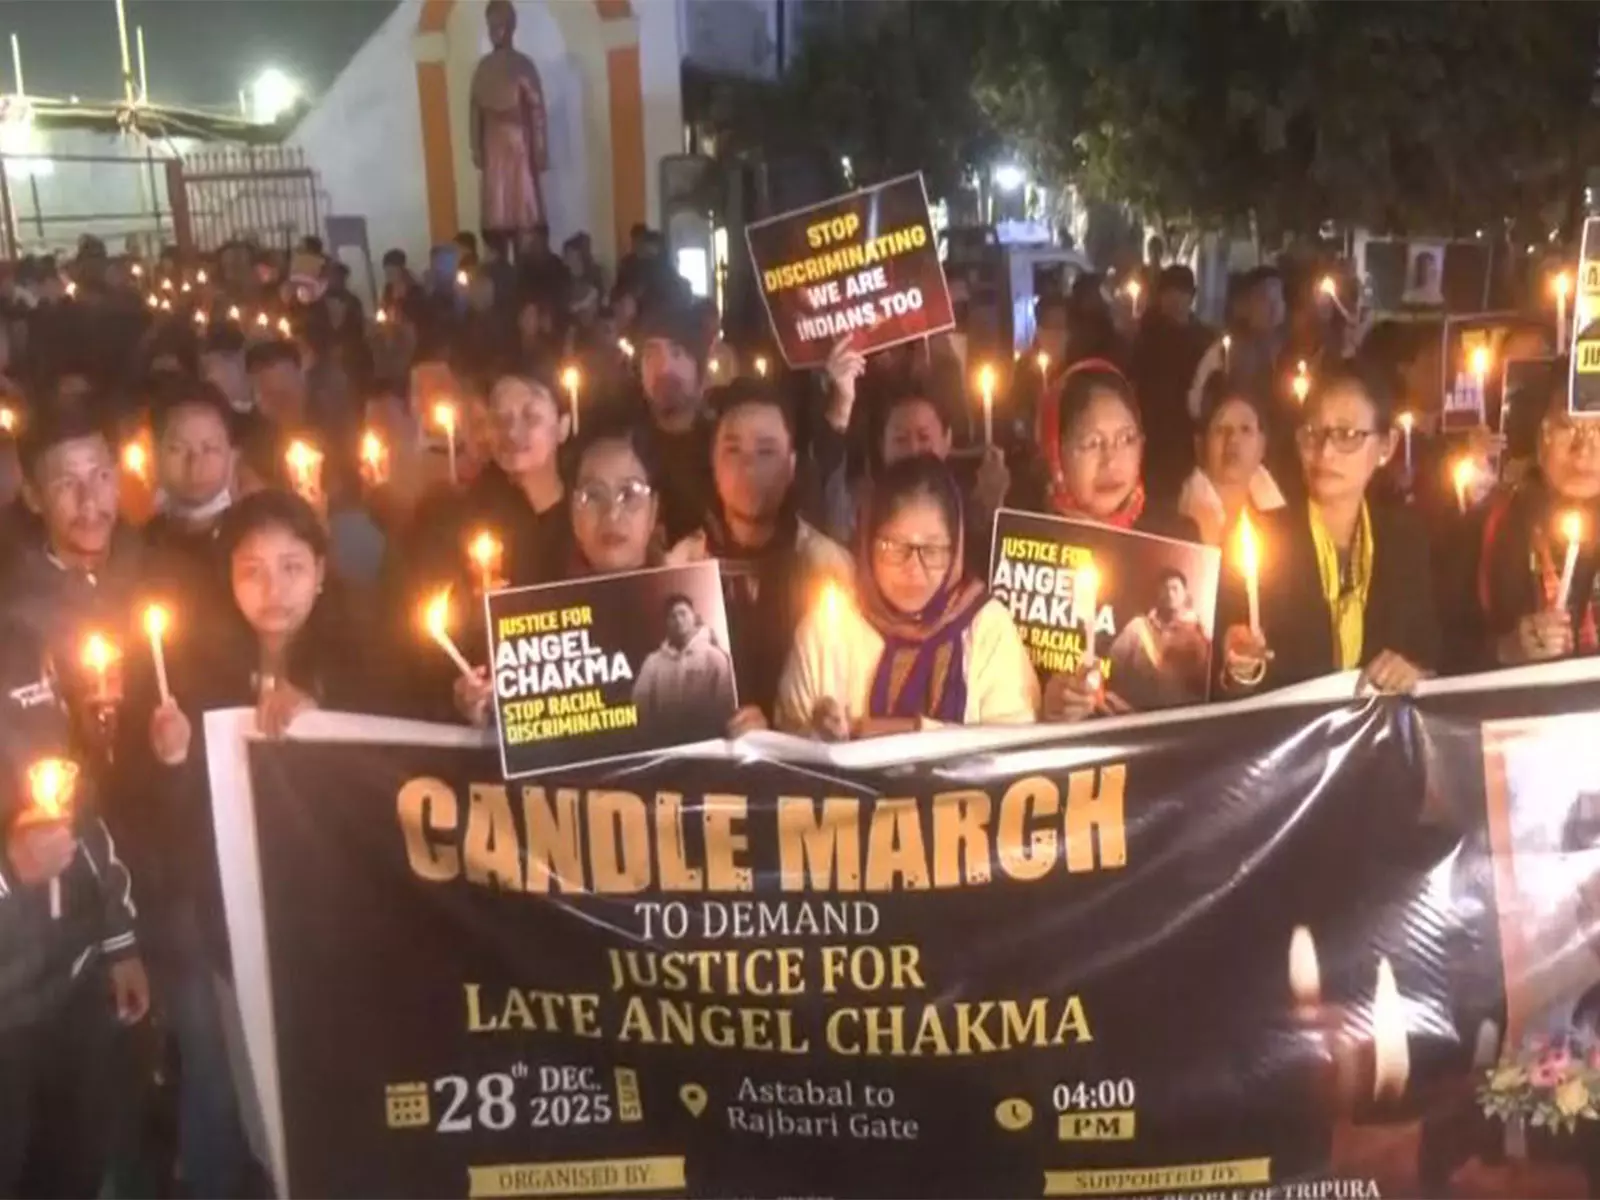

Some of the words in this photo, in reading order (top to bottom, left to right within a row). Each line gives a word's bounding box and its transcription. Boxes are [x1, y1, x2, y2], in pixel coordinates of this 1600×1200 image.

[807, 213, 859, 248] STOP
[763, 225, 927, 292] DISCRIMINATING
[807, 281, 842, 309] WE
[846, 267, 888, 298] ARE
[796, 302, 876, 342] INDIANS
[879, 287, 924, 318] TOO
[1002, 536, 1058, 562] JUSTICE
[992, 558, 1074, 599] ANGE
[499, 611, 561, 639] JUSTICE
[561, 606, 593, 629] FOR
[993, 588, 1116, 636] HAKA
[495, 629, 602, 669] ANGEL
[1030, 627, 1084, 655] RACIAL
[496, 652, 634, 698] CHAKMA
[503, 699, 545, 723] STOP
[547, 689, 605, 714] RACIAL
[506, 704, 639, 744] DISCRIMINATION
[398, 776, 754, 893] CANDLE
[777, 764, 1128, 893] MARCH
[634, 901, 690, 940] TO
[701, 900, 880, 940] DEMAND
[609, 946, 805, 996] JUSTICE
[820, 944, 925, 991] FOR
[464, 982, 602, 1040] LATE
[618, 996, 809, 1055] ANGEL
[825, 994, 1094, 1058] CHAKMA
[539, 1065, 602, 1093] DEC.
[737, 1076, 853, 1108] Astabal
[864, 1082, 895, 1108] to
[1052, 1078, 1136, 1111] 04:00
[530, 1094, 613, 1128] 2025
[727, 1108, 839, 1138] Rajbari
[848, 1114, 919, 1139] Gate
[1073, 1116, 1121, 1137] PM
[499, 1165, 618, 1189] ORGANISED
[1075, 1166, 1205, 1189] SUPPORTED
[1282, 1179, 1381, 1199] TRIPURA
